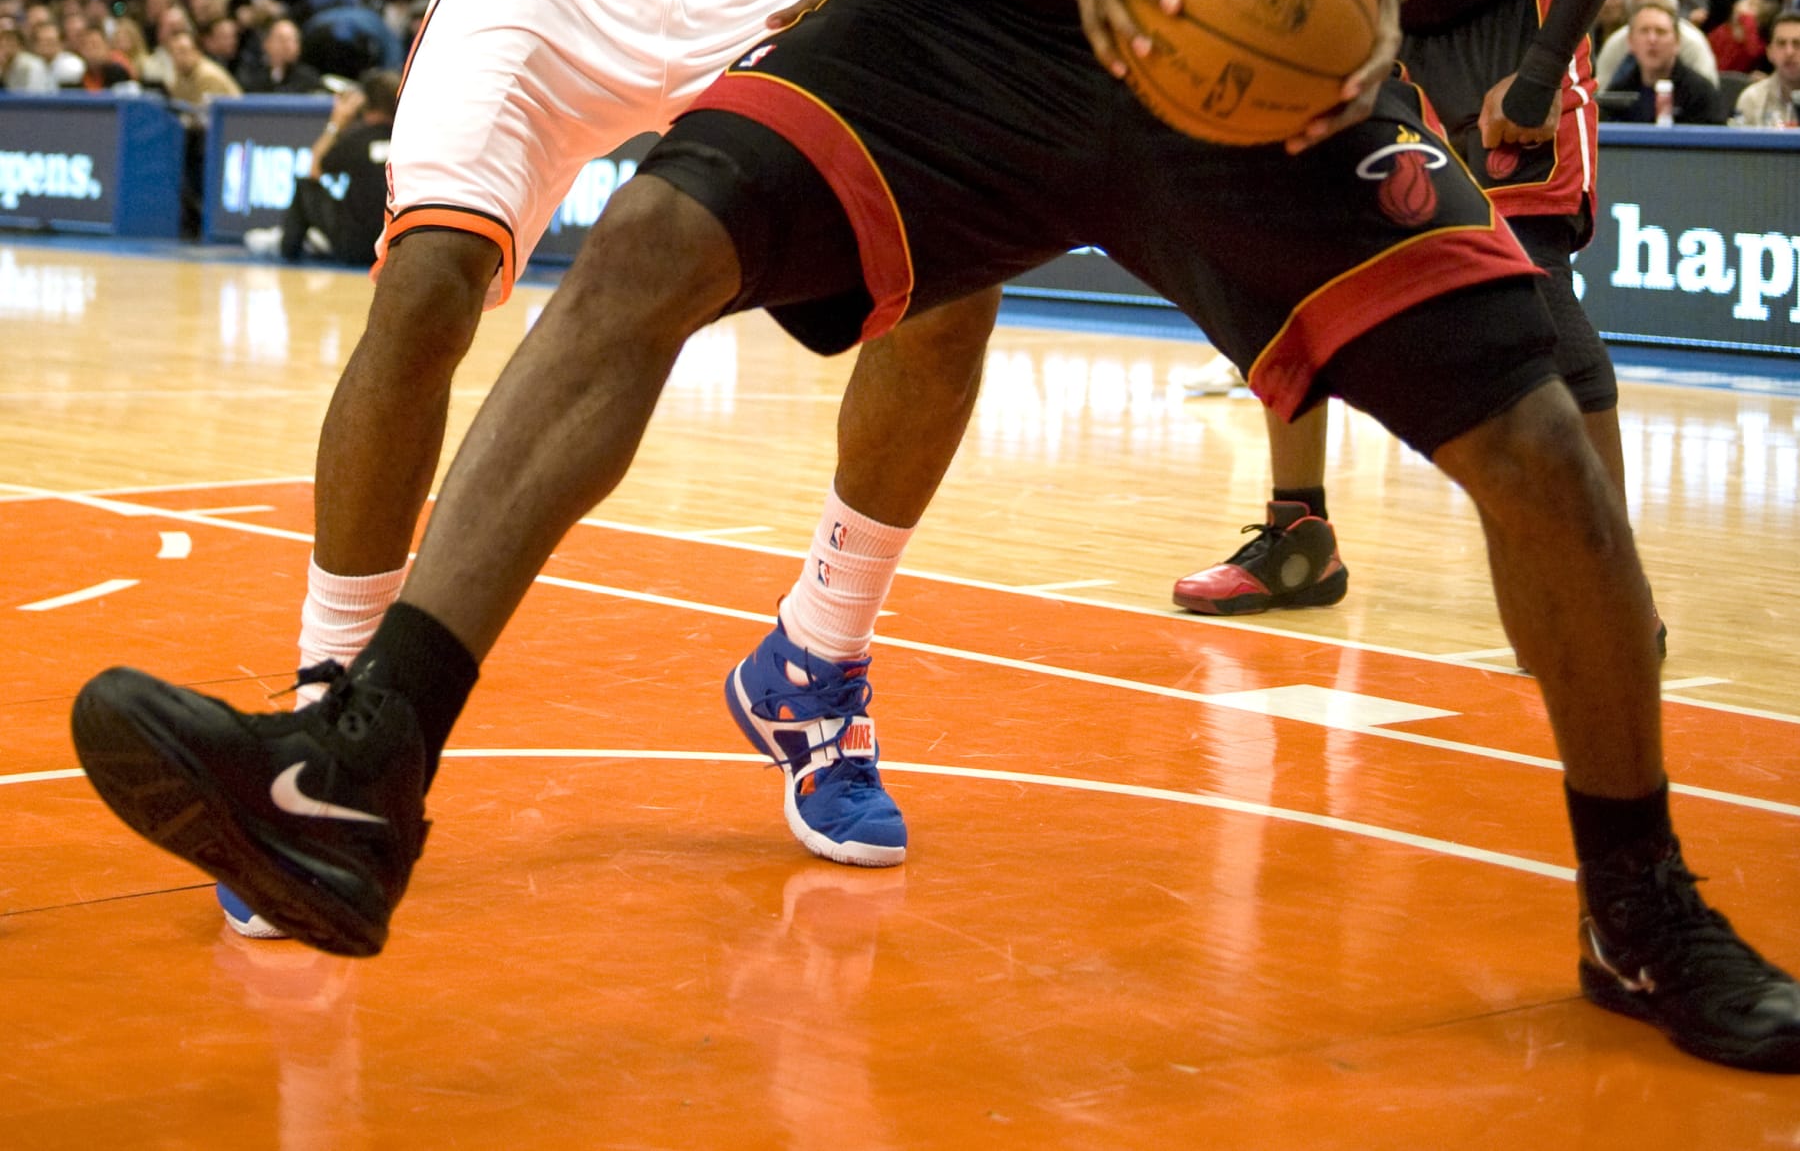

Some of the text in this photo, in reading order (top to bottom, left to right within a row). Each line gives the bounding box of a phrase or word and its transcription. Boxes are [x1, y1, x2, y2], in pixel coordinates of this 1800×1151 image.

[0, 150, 102, 210] pens.
[1611, 203, 1800, 323] hap
[840, 725, 872, 750] NIKE
